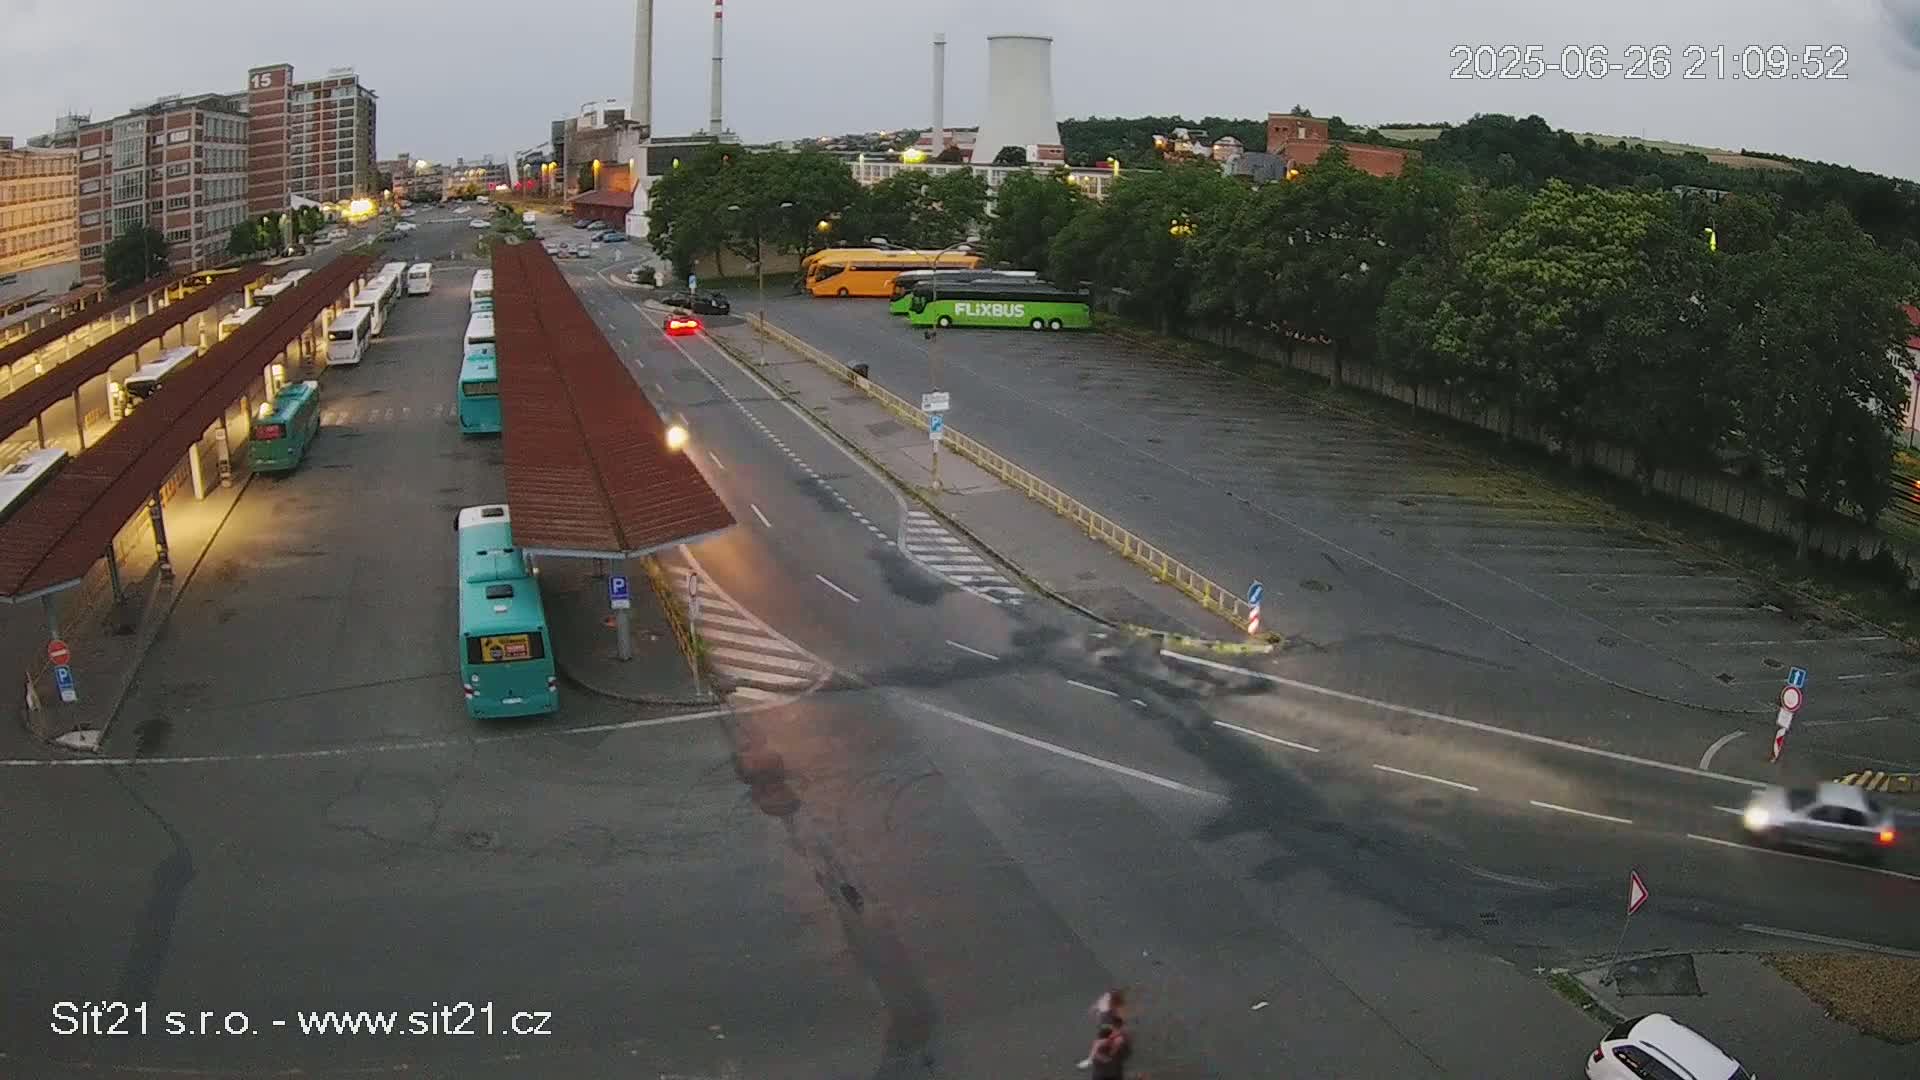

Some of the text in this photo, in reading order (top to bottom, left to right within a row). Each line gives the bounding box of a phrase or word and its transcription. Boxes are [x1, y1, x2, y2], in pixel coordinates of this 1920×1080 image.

[250, 72, 272, 89] 15
[612, 578, 626, 594] P
[58, 668, 69, 682] P
